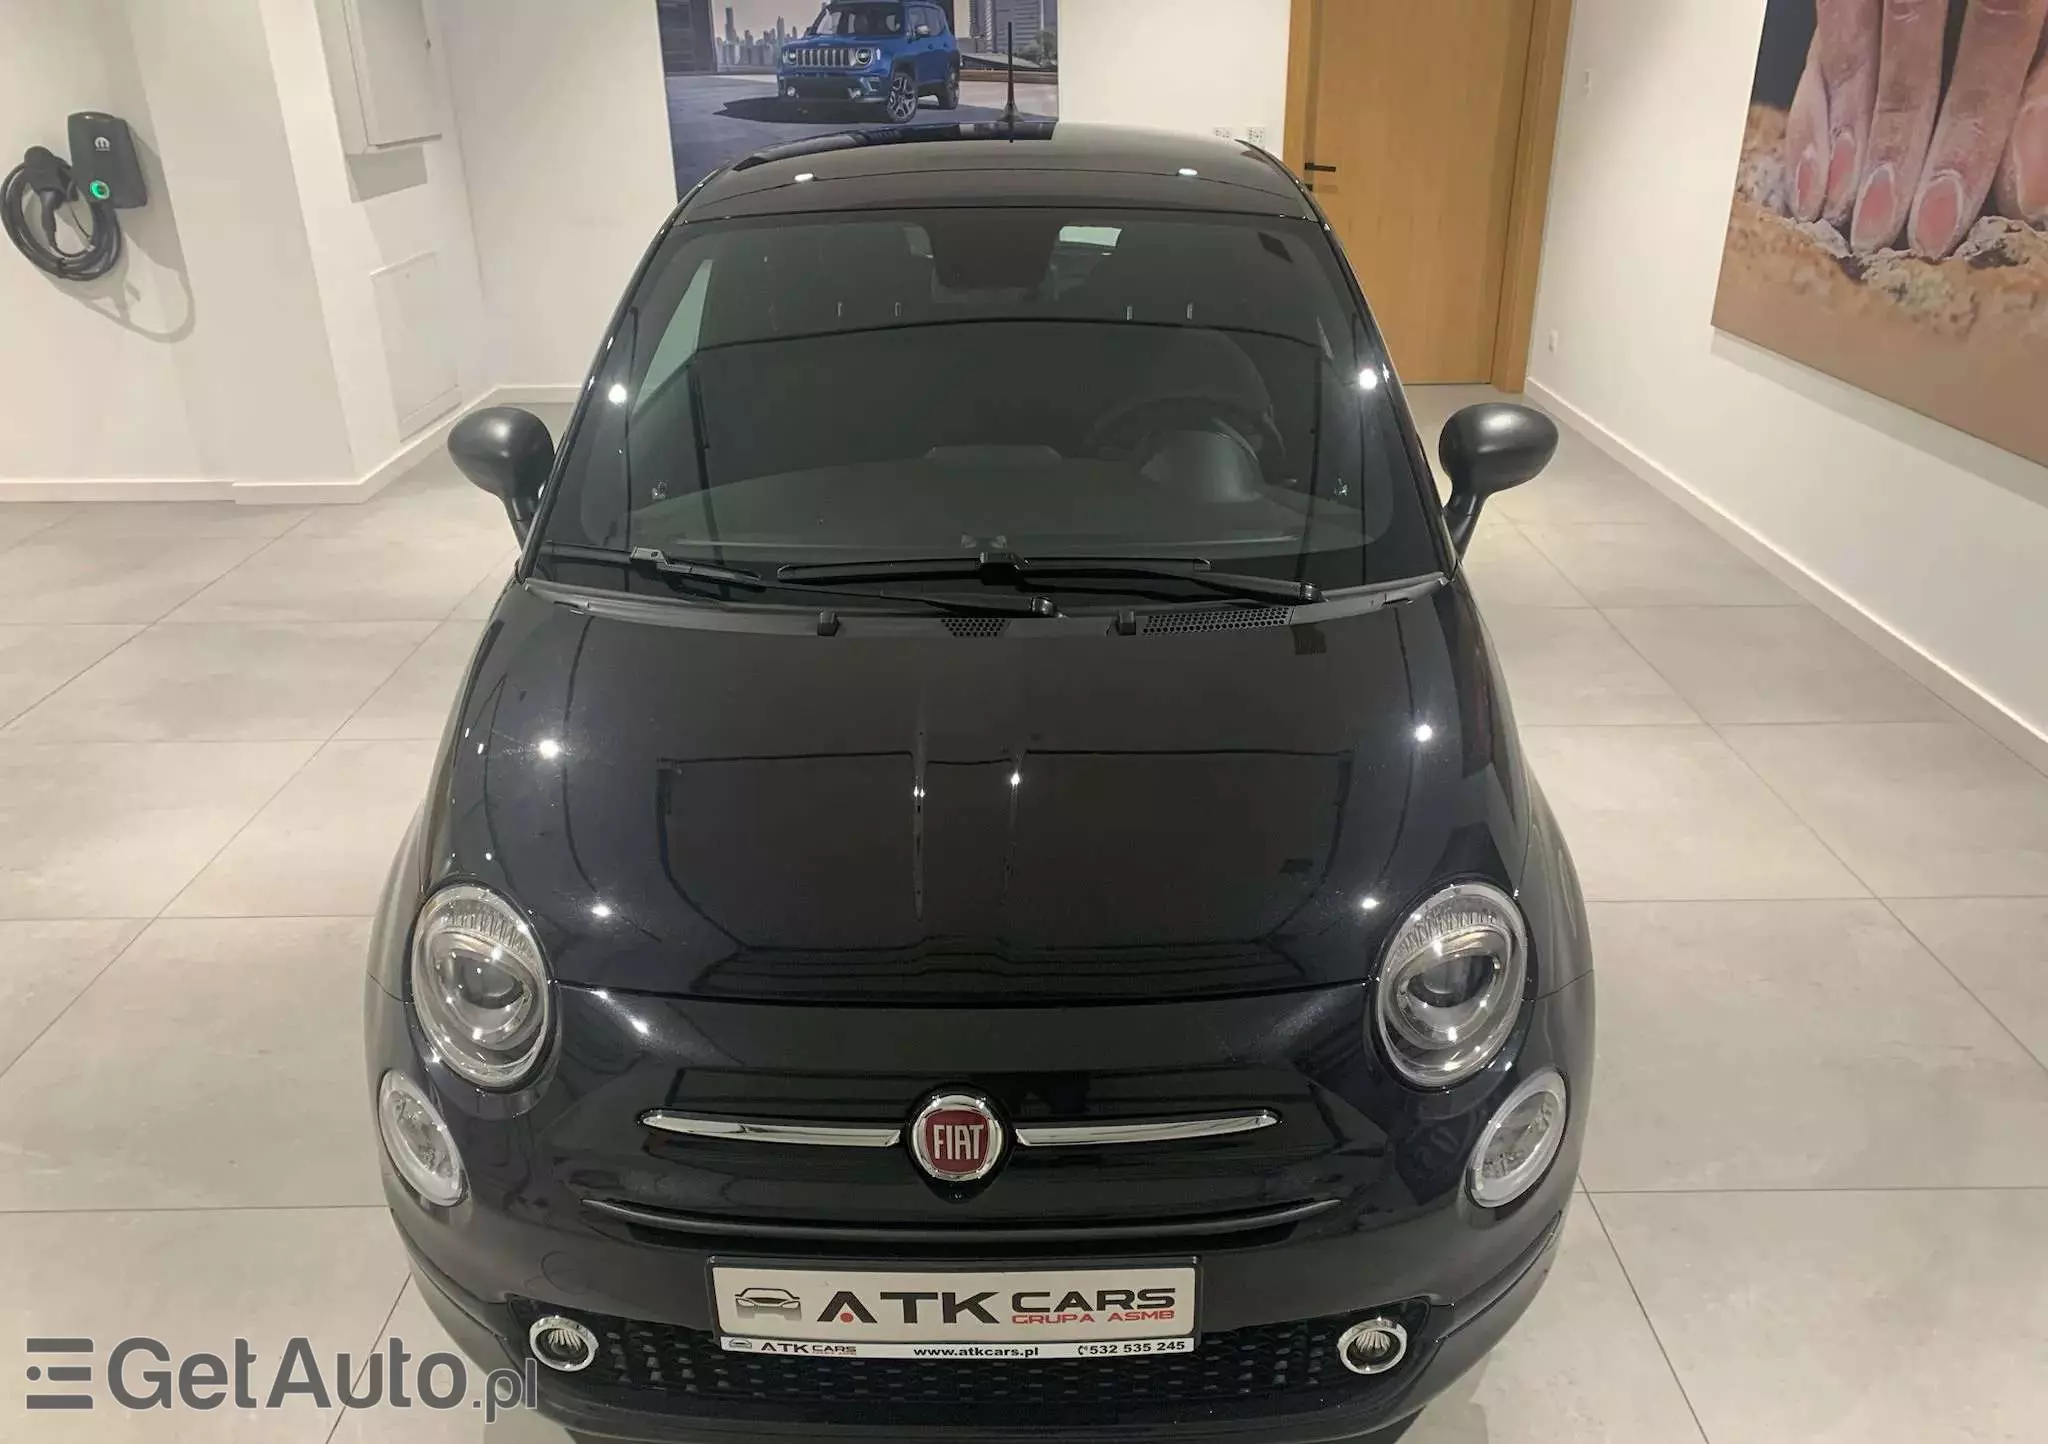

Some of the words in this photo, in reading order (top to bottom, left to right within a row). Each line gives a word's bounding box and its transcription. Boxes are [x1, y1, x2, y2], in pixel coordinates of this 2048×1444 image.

[933, 1124, 984, 1160] FIAT
[816, 1291, 1000, 1324] ATK
[1011, 1288, 1176, 1313] CARS
[1012, 1313, 1096, 1325] GRUPA
[1107, 1310, 1175, 1323] ASMB
[760, 1341, 810, 1354] ATK
[811, 1344, 857, 1354] CARS
[913, 1347, 1039, 1358] www.atkcars.pl
[1089, 1345, 1118, 1355] 532
[1123, 1343, 1152, 1353] 535
[1156, 1341, 1185, 1351] 245
